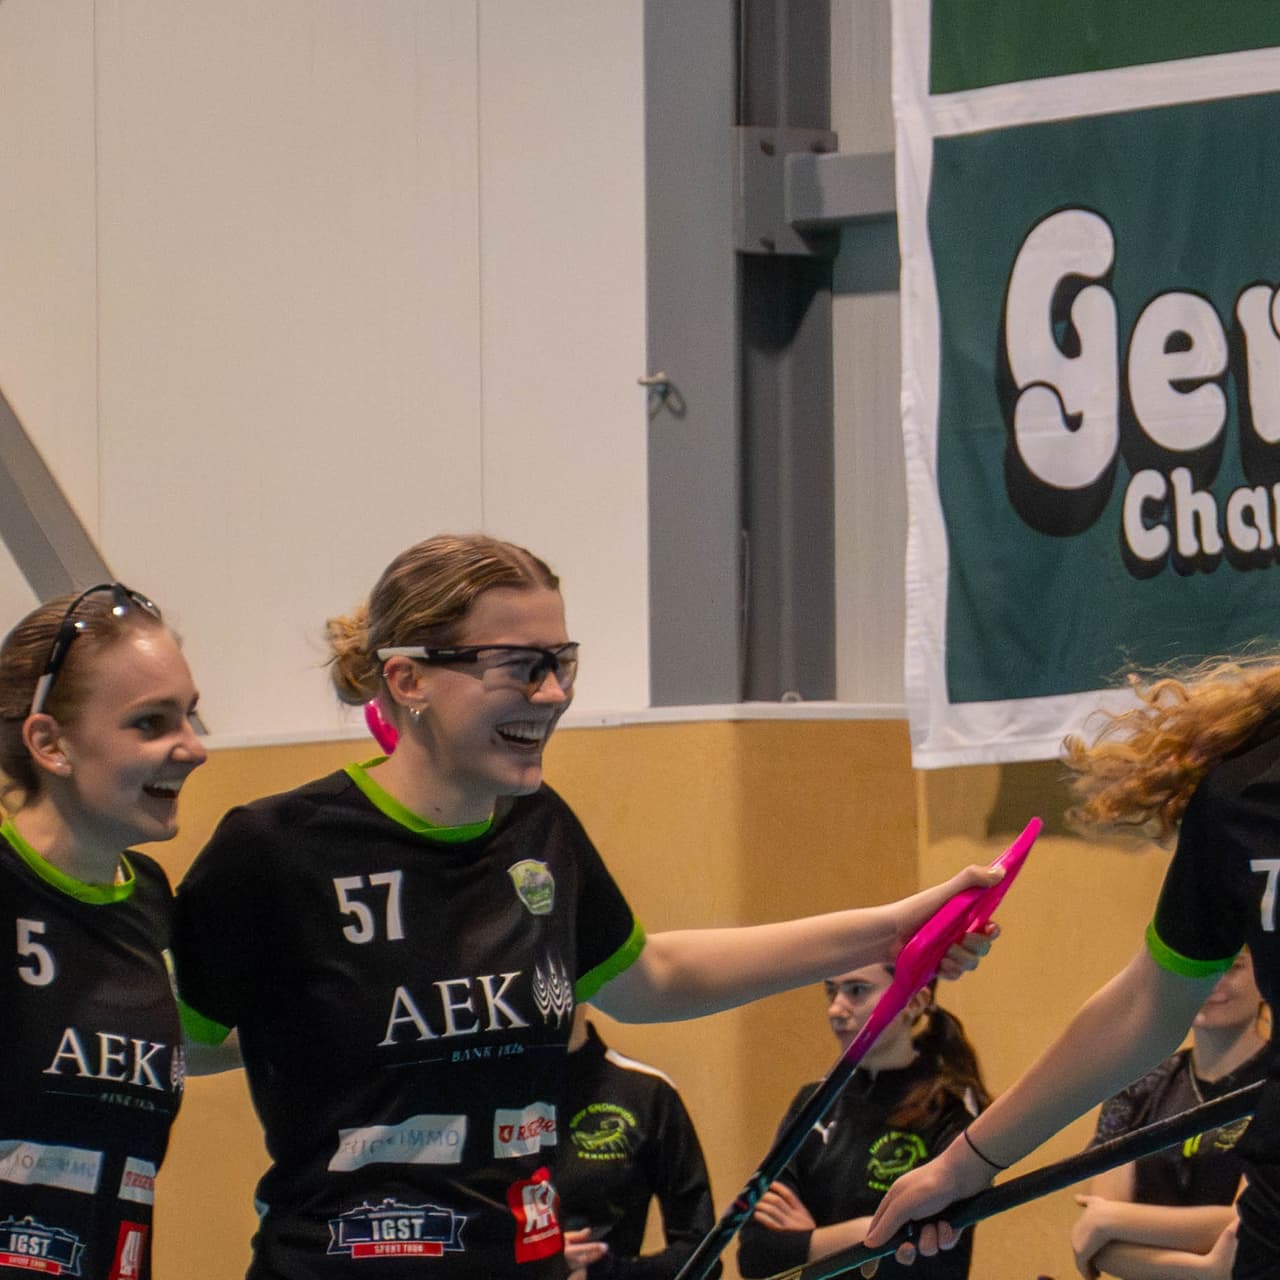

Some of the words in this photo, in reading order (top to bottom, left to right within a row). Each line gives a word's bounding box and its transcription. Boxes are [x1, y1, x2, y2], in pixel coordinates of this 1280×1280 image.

[332, 869, 406, 945] 57
[15, 918, 55, 987] 5
[377, 971, 531, 1048] AEK
[42, 1027, 167, 1091] AEK
[9, 1233, 53, 1257] IGST
[372, 1216, 425, 1241] IGST
